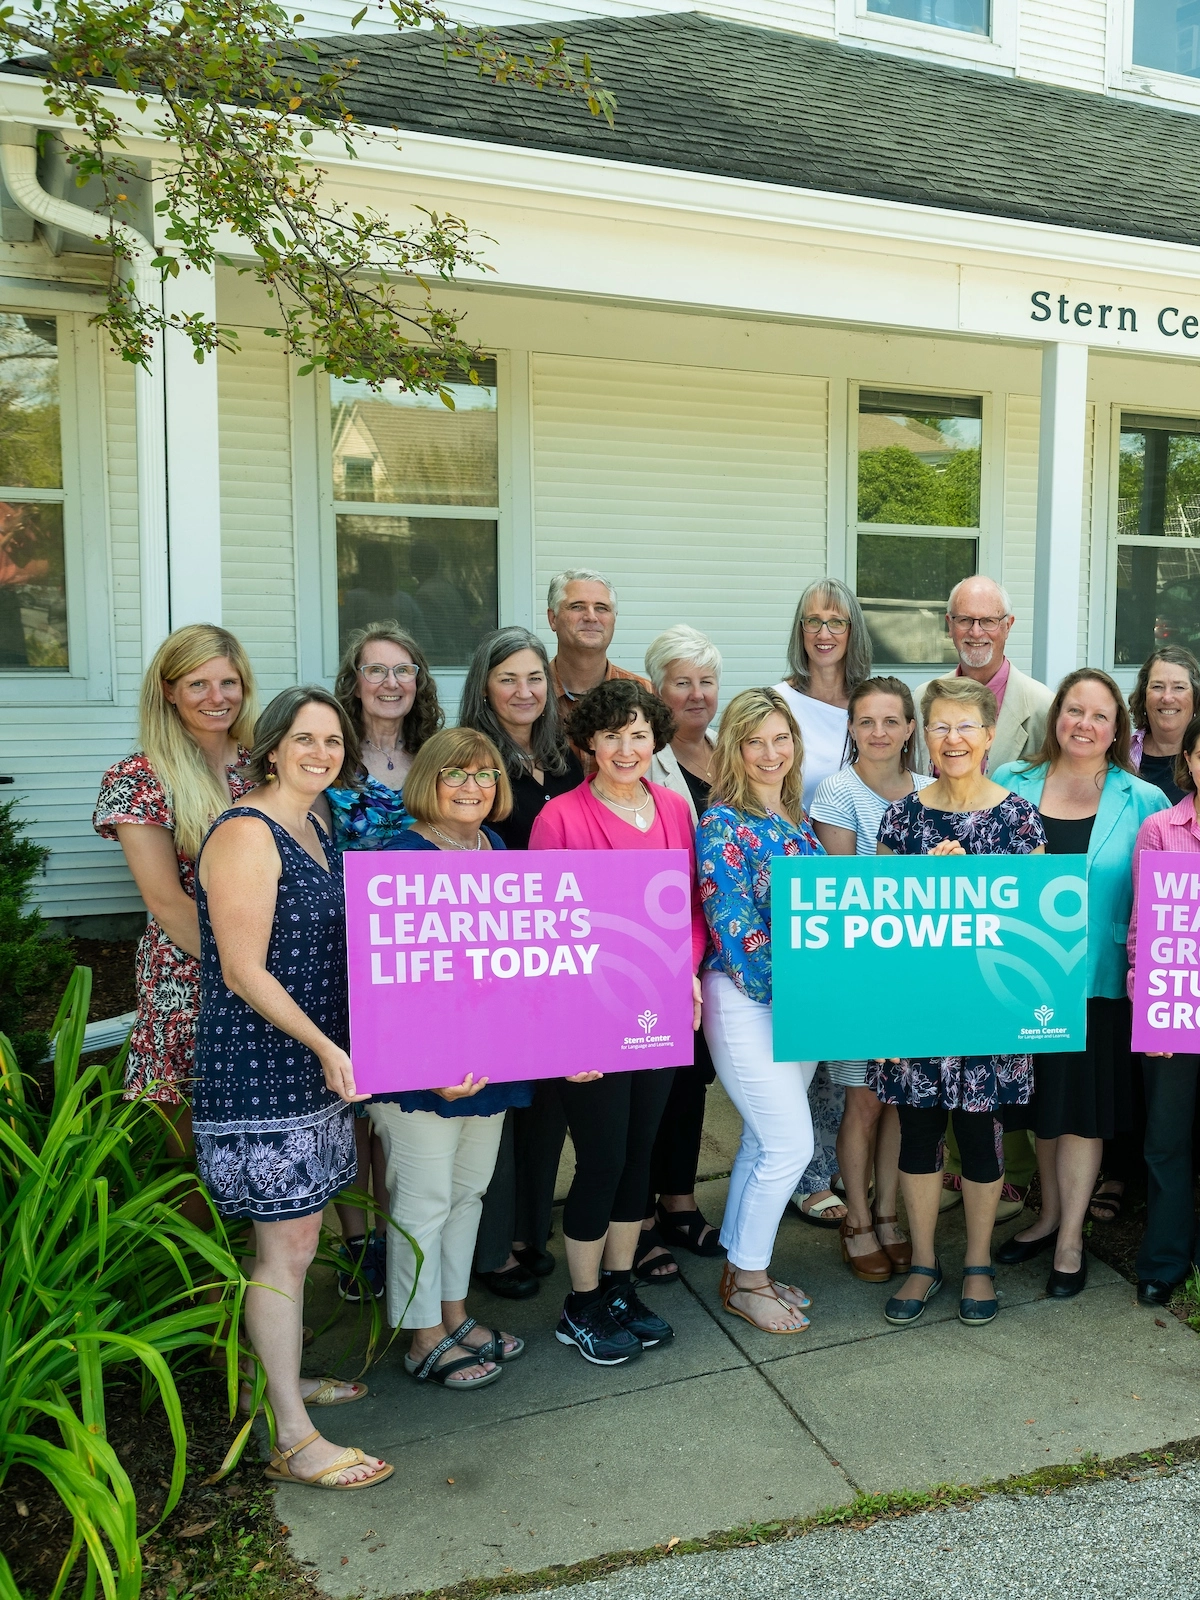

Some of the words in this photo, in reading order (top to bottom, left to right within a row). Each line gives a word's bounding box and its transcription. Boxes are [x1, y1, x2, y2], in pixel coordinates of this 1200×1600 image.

[1030, 291, 1138, 332] Stern
[366, 872, 543, 906] CHANGE
[554, 872, 584, 903] A
[790, 876, 1019, 911] LEARNING
[369, 908, 592, 945] LEARNER'S
[791, 915, 830, 949] IS
[844, 913, 1004, 948] POWER
[370, 950, 454, 984] LIFE
[466, 943, 600, 980] TODAY
